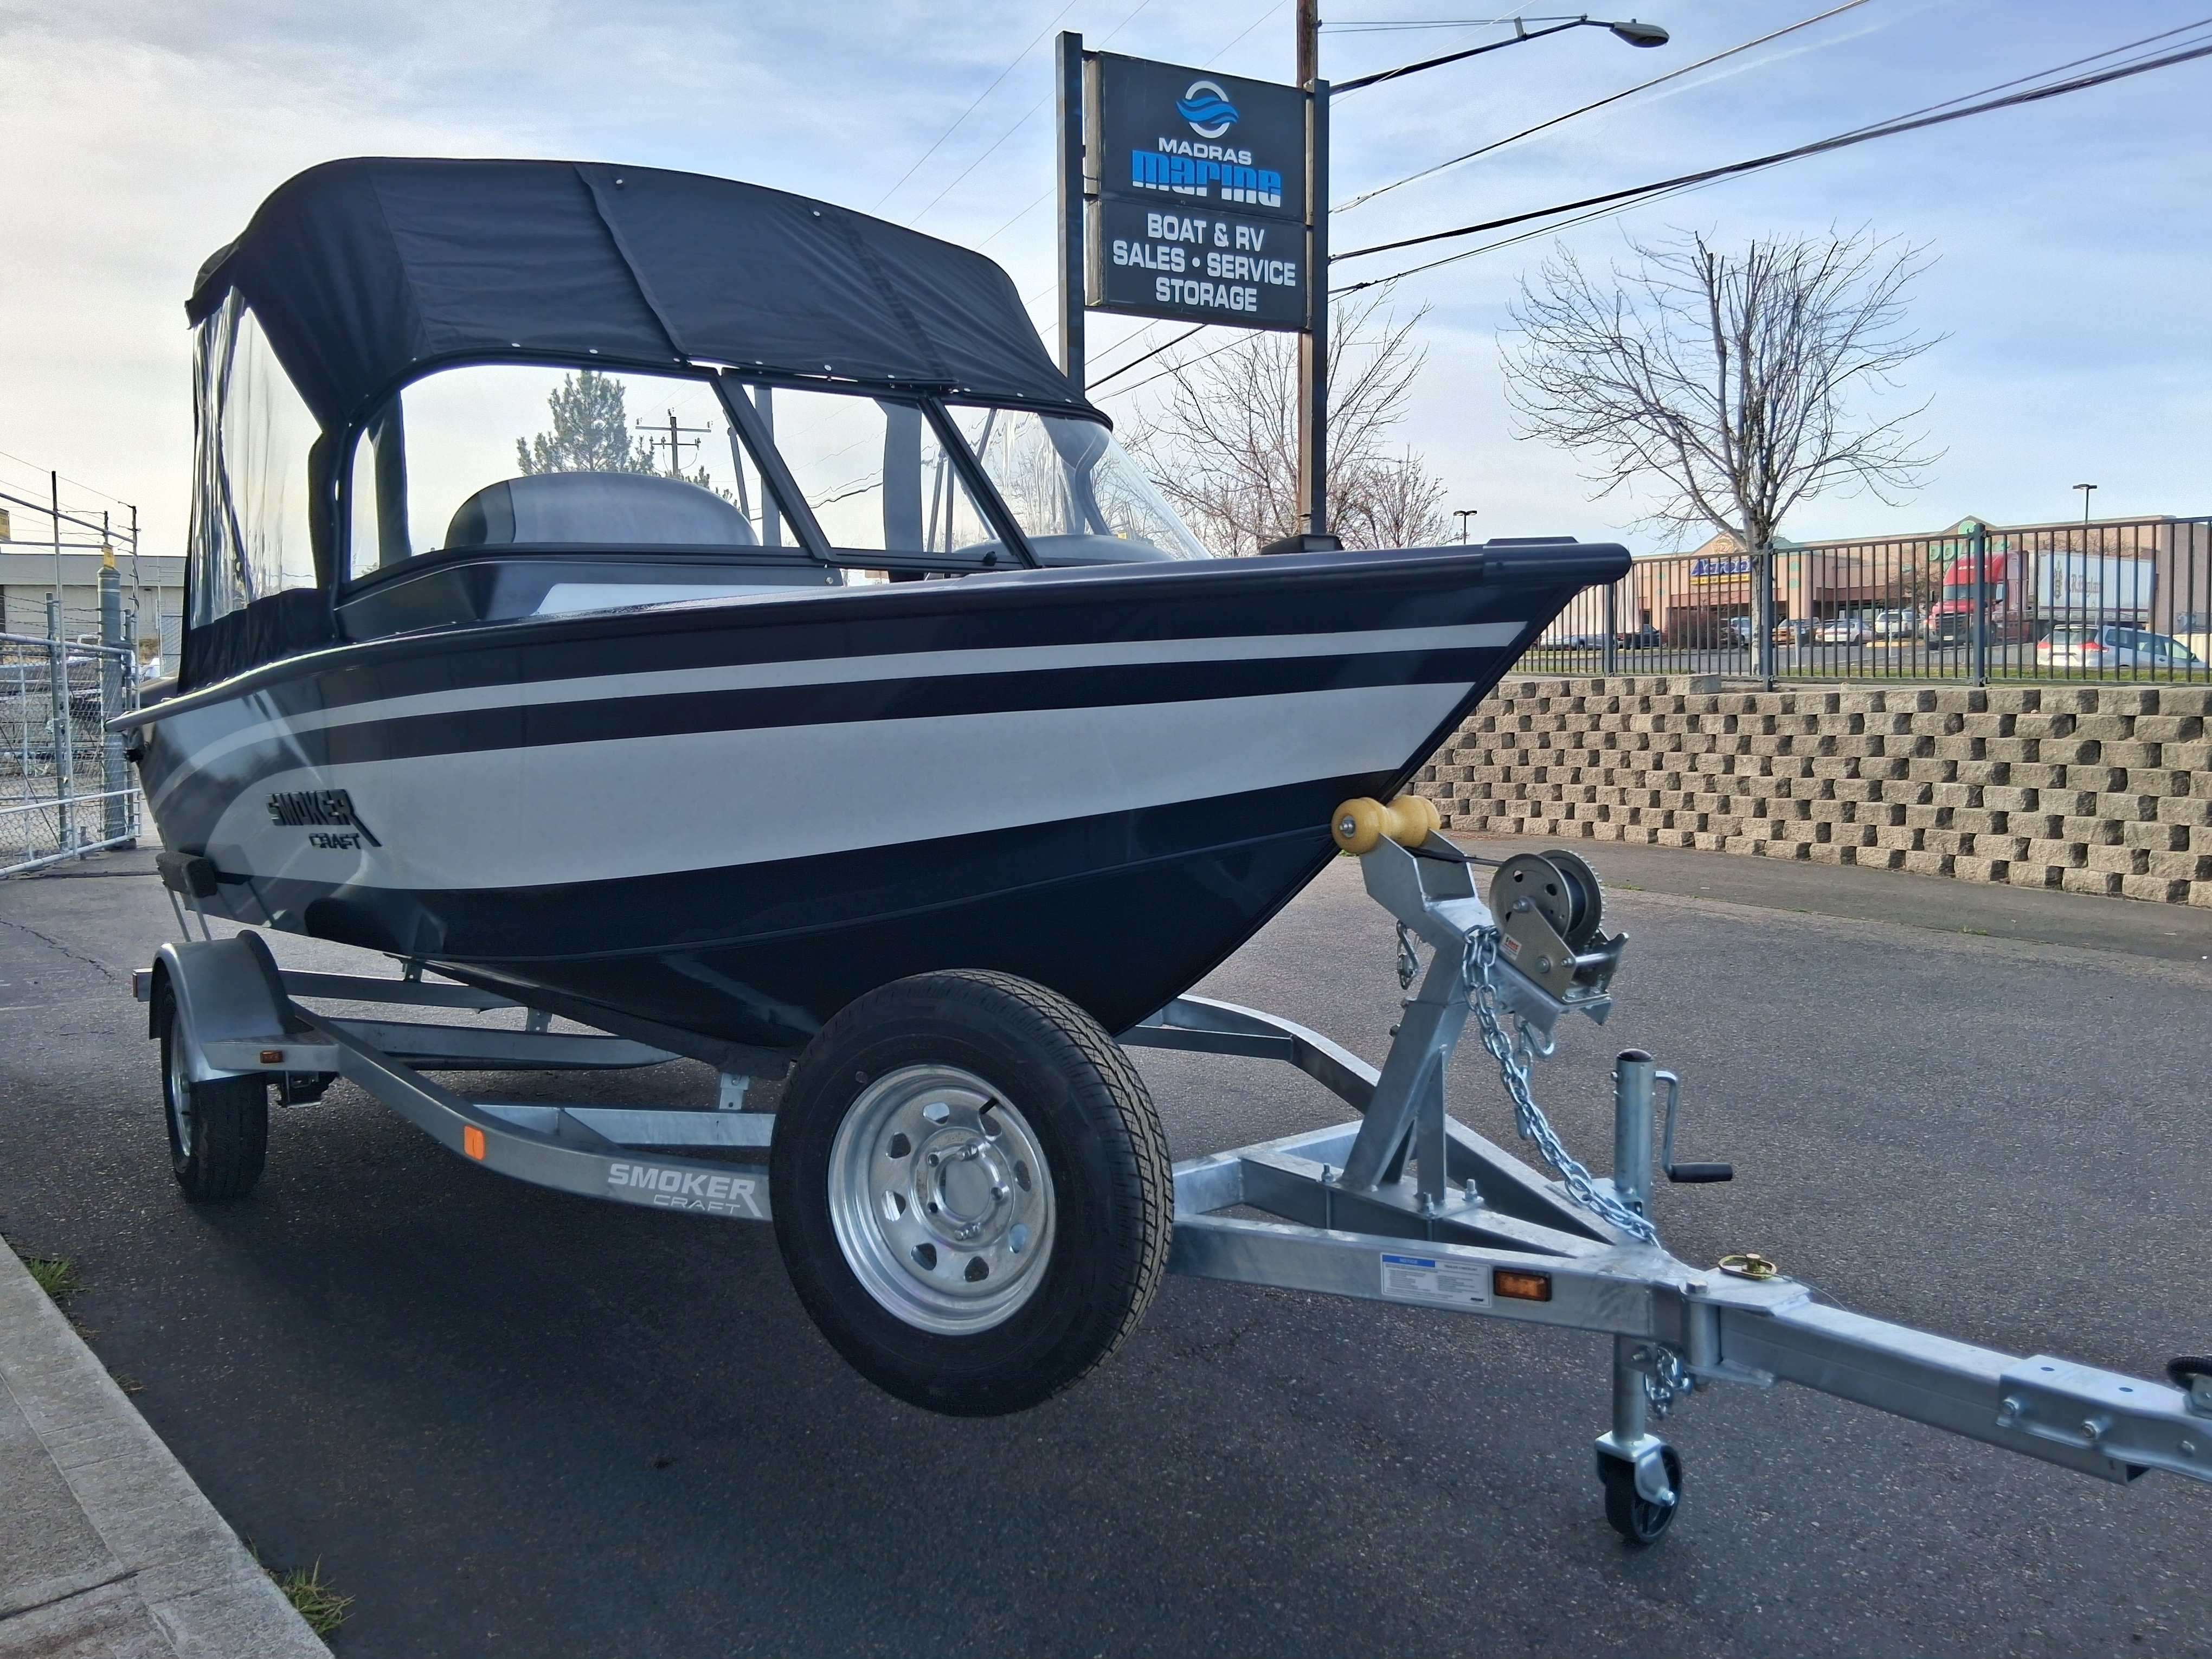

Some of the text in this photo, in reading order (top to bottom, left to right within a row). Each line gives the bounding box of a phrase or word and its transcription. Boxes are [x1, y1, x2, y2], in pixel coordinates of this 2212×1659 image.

[1158, 137, 1252, 165] MADRAS
[1132, 150, 1282, 208] marine
[1147, 213, 1265, 252] BOAT & RV
[1113, 240, 1296, 287] SALES SERVICE
[1155, 276, 1257, 312] STORAGE
[266, 789, 382, 847] SMOKER
[308, 833, 361, 850] CRAFT
[608, 1163, 763, 1218] SMOKER
[653, 1194, 741, 1214] CRAFT
